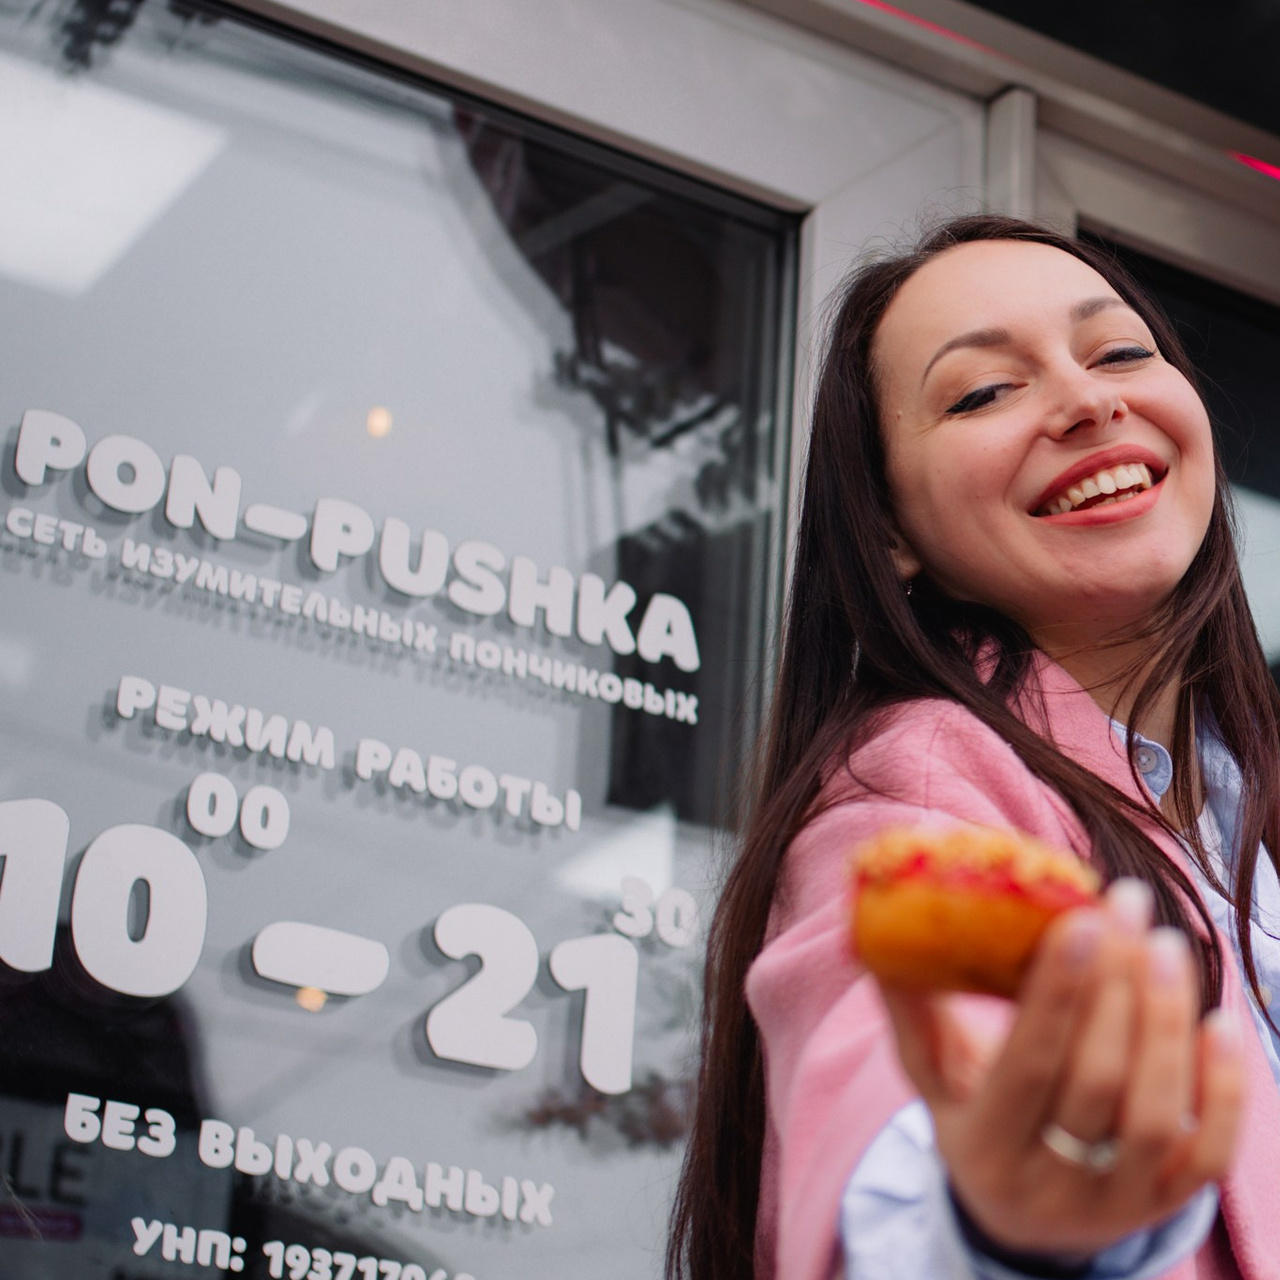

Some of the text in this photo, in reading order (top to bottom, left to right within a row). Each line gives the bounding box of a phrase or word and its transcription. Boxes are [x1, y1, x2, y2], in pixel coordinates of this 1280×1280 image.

[5, 507, 699, 725] СЕТЬ ИЗУМИТЕЛЬНЫХ ПОНЧИКОВЫХ
[15, 409, 701, 672] PON-PUSHKA
[117, 675, 582, 832] РЕЖИМ РАБОТЫ
[187, 772, 291, 850] 00
[426, 903, 640, 1095] 21
[613, 877, 698, 947] 30
[0, 1130, 94, 1207] LE
[64, 1093, 555, 1226] БЕЗ ВЫХОДНЫХ
[131, 1217, 247, 1272] УНП:
